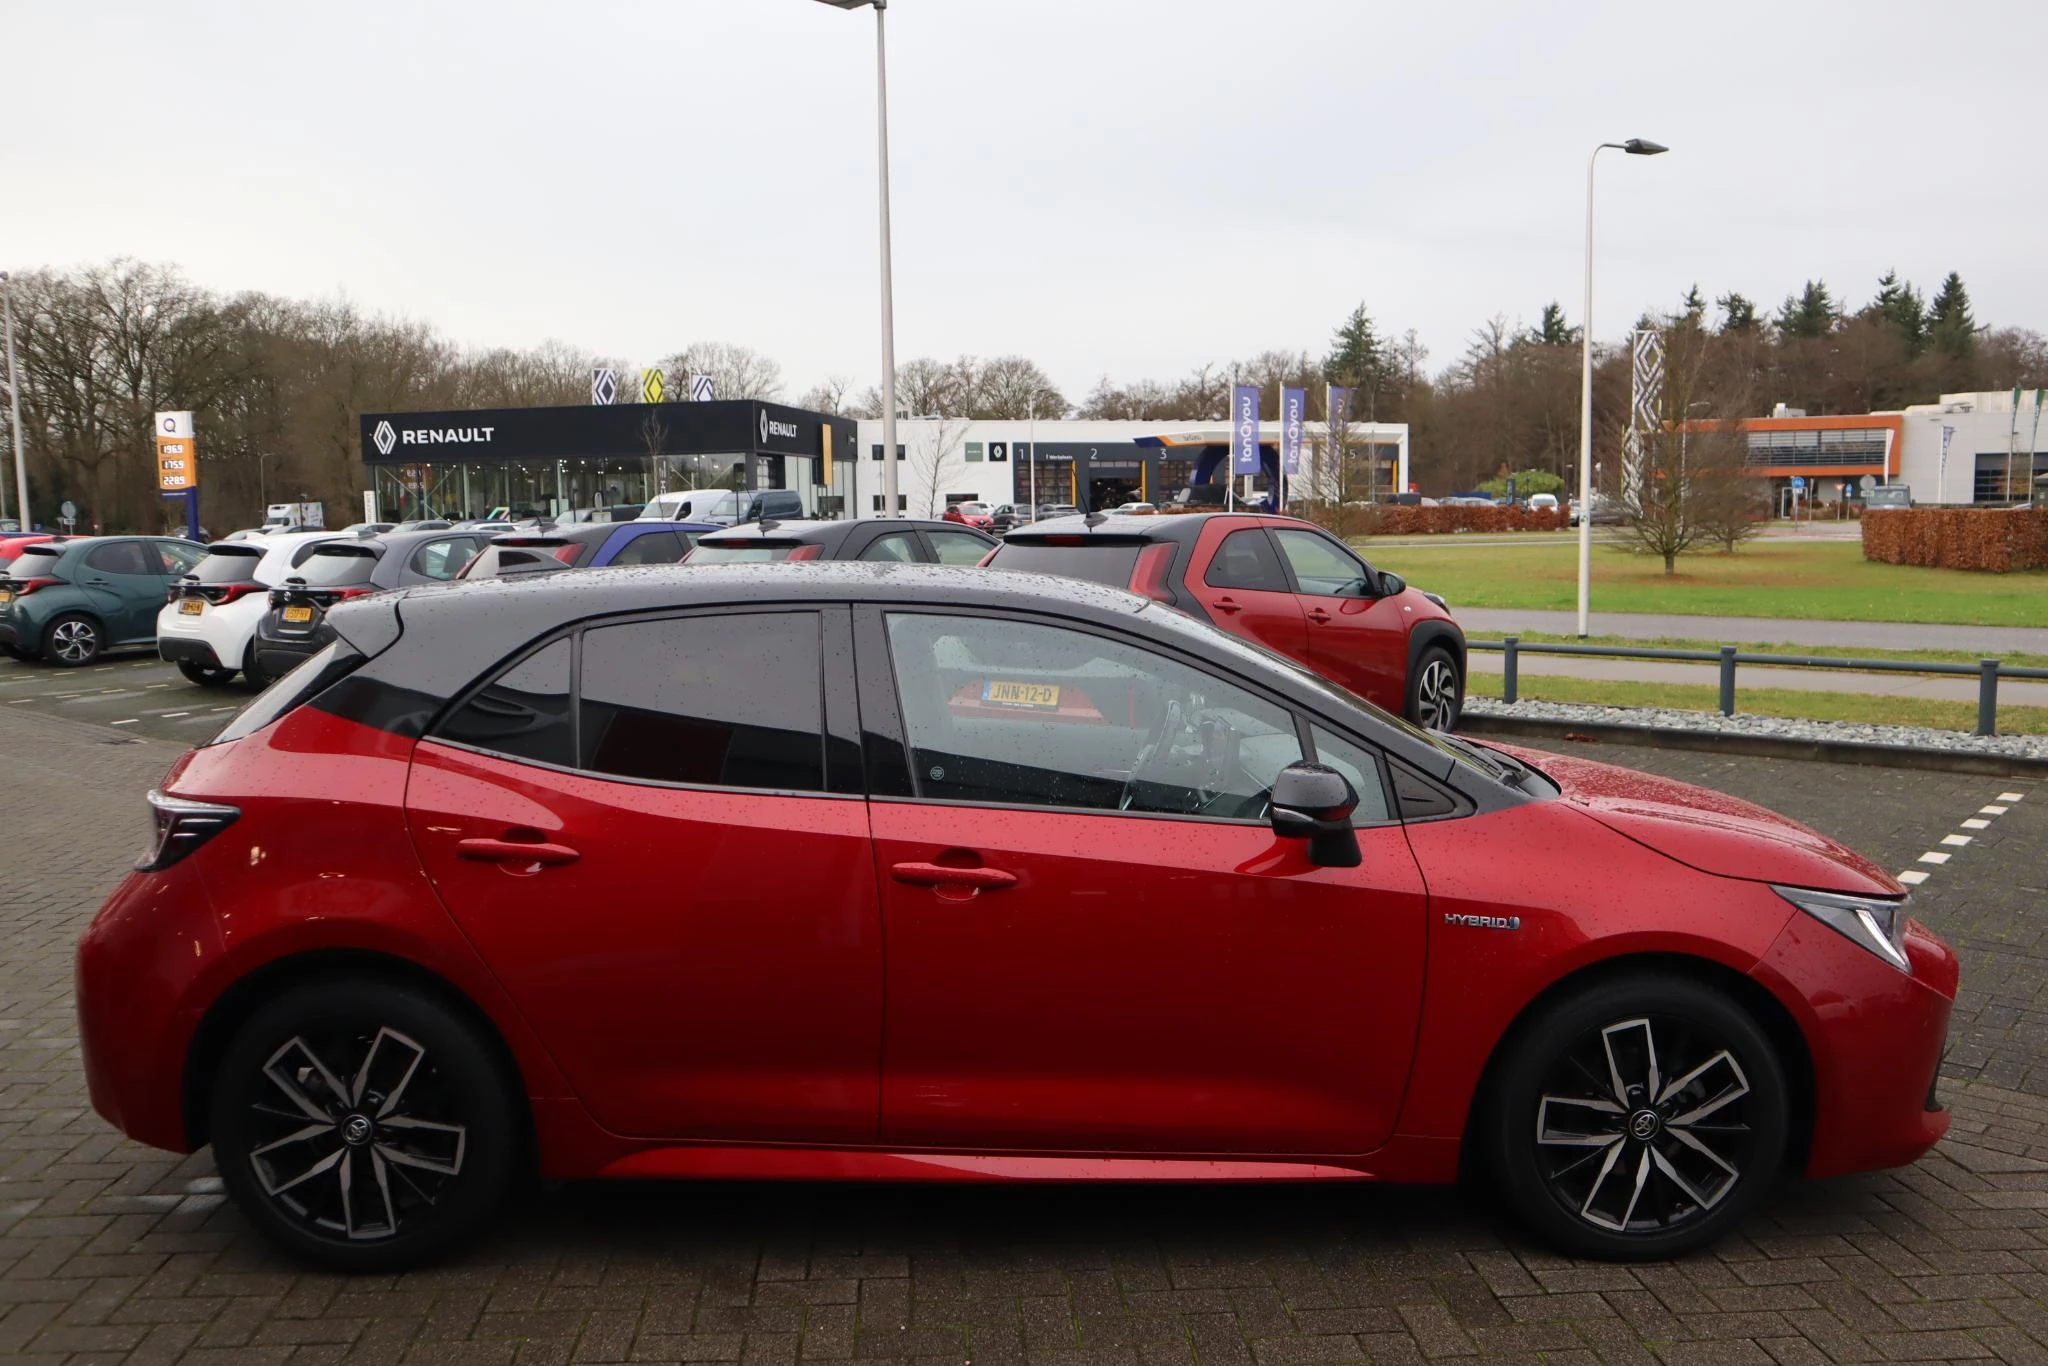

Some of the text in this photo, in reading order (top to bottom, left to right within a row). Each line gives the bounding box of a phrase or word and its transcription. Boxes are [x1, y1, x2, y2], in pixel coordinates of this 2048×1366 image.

[402, 427, 494, 444] RENAULT
[769, 420, 797, 438] RENAULT
[1090, 448, 1098, 460] 2
[1159, 448, 1167, 460] 3
[1444, 913, 1508, 929] HYBRID
